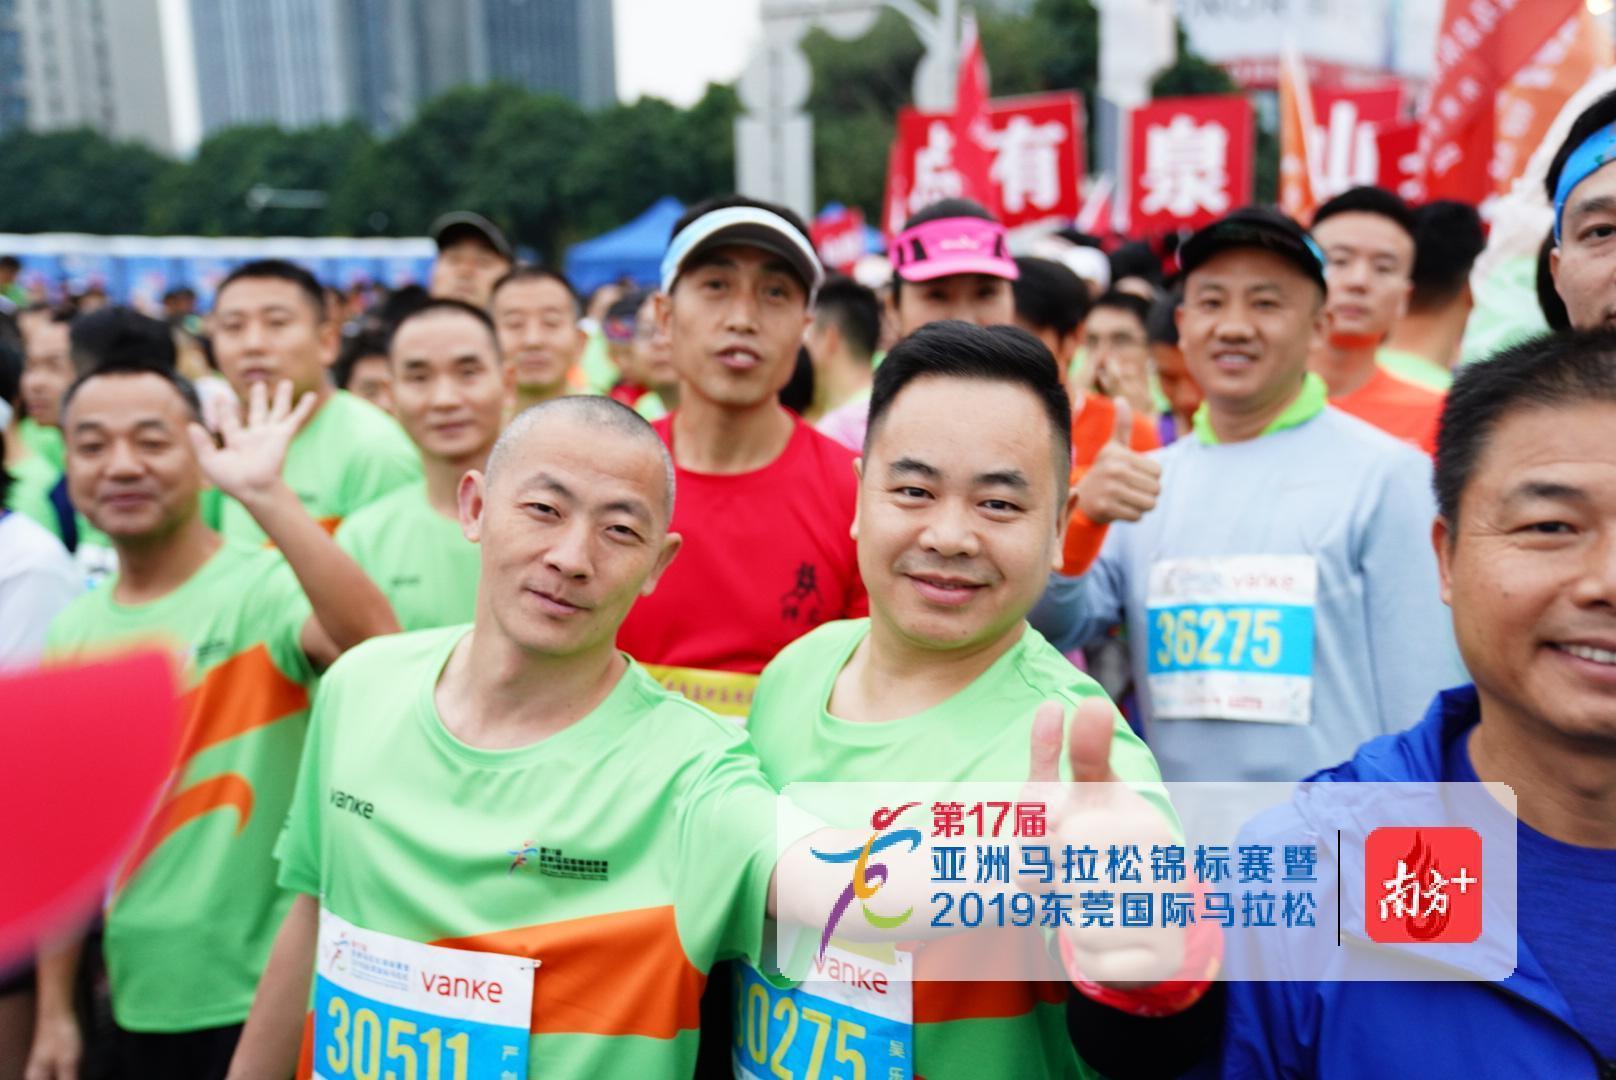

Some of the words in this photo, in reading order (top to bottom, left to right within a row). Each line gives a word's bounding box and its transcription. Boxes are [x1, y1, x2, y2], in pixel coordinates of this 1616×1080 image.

[1156, 609, 1282, 668] 36275
[330, 787, 374, 820] vanke
[421, 971, 503, 1003] vanke
[813, 954, 888, 994] vanke
[325, 996, 470, 1080] 30511
[738, 970, 867, 1080] 0275
